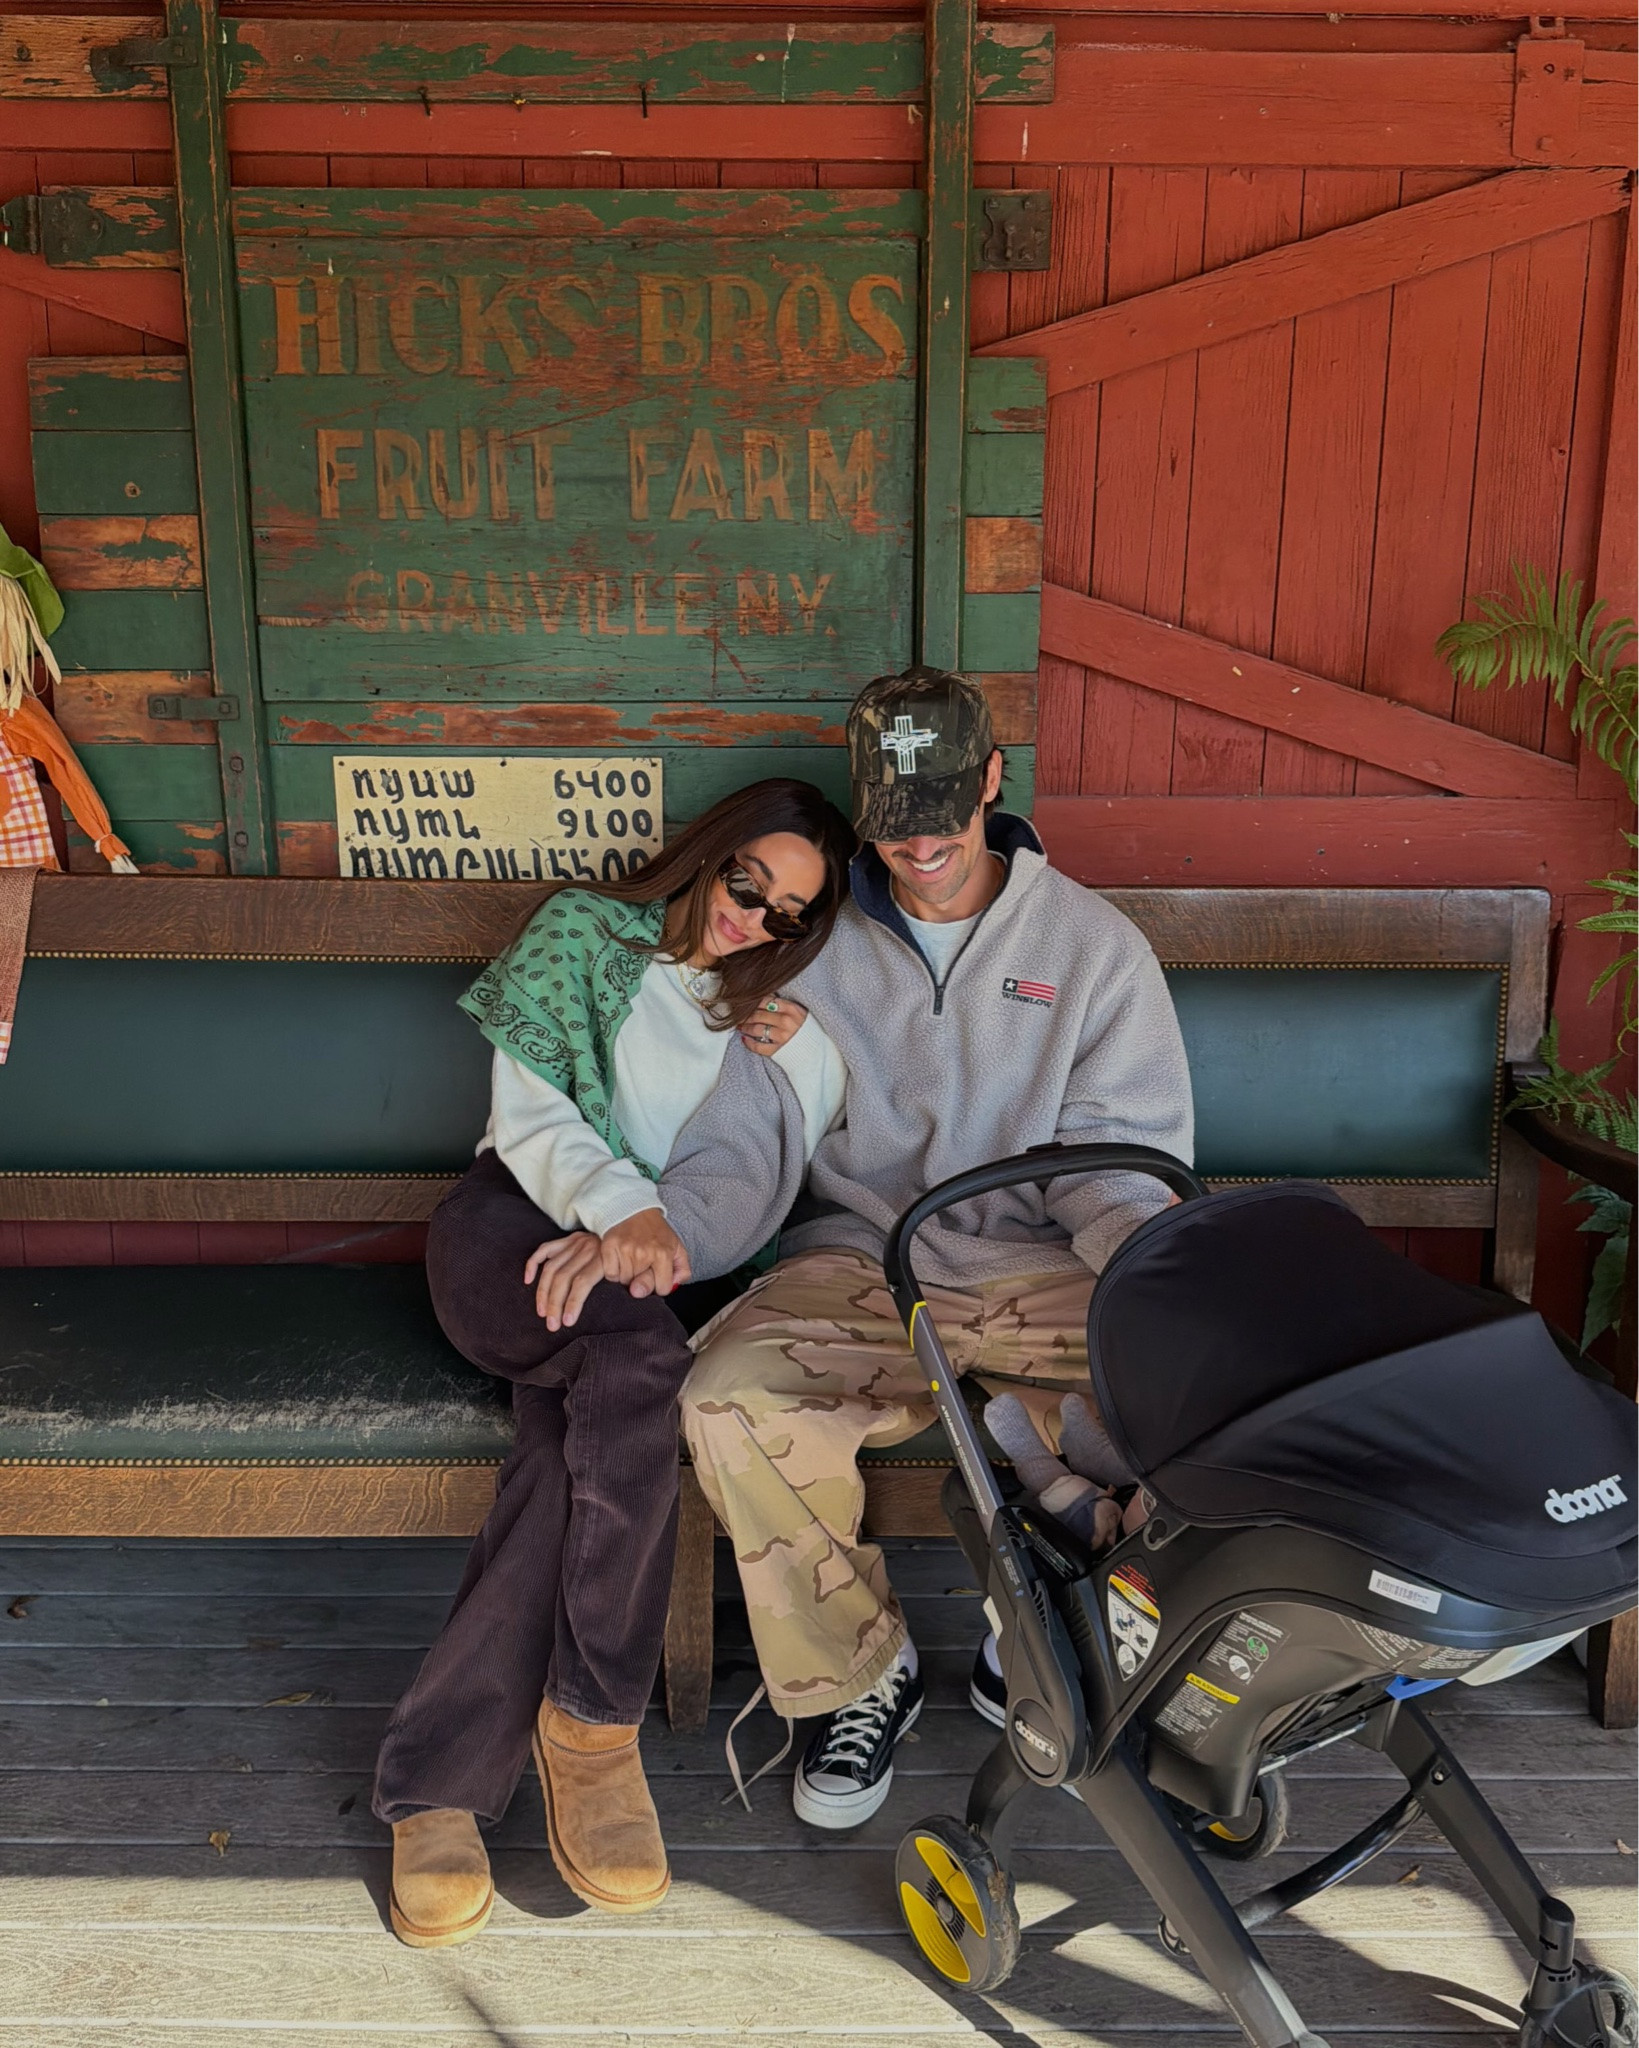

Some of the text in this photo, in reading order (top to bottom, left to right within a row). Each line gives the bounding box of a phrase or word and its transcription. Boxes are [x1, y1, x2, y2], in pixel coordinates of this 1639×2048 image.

[266, 273, 907, 377] HICKS BROS
[316, 428, 877, 522] FRUIT FARM
[346, 570, 709, 637] GRANVILLE
[553, 768, 652, 799] 6400
[557, 808, 653, 838] 9100
[1001, 991, 1053, 1008] WINSLOW
